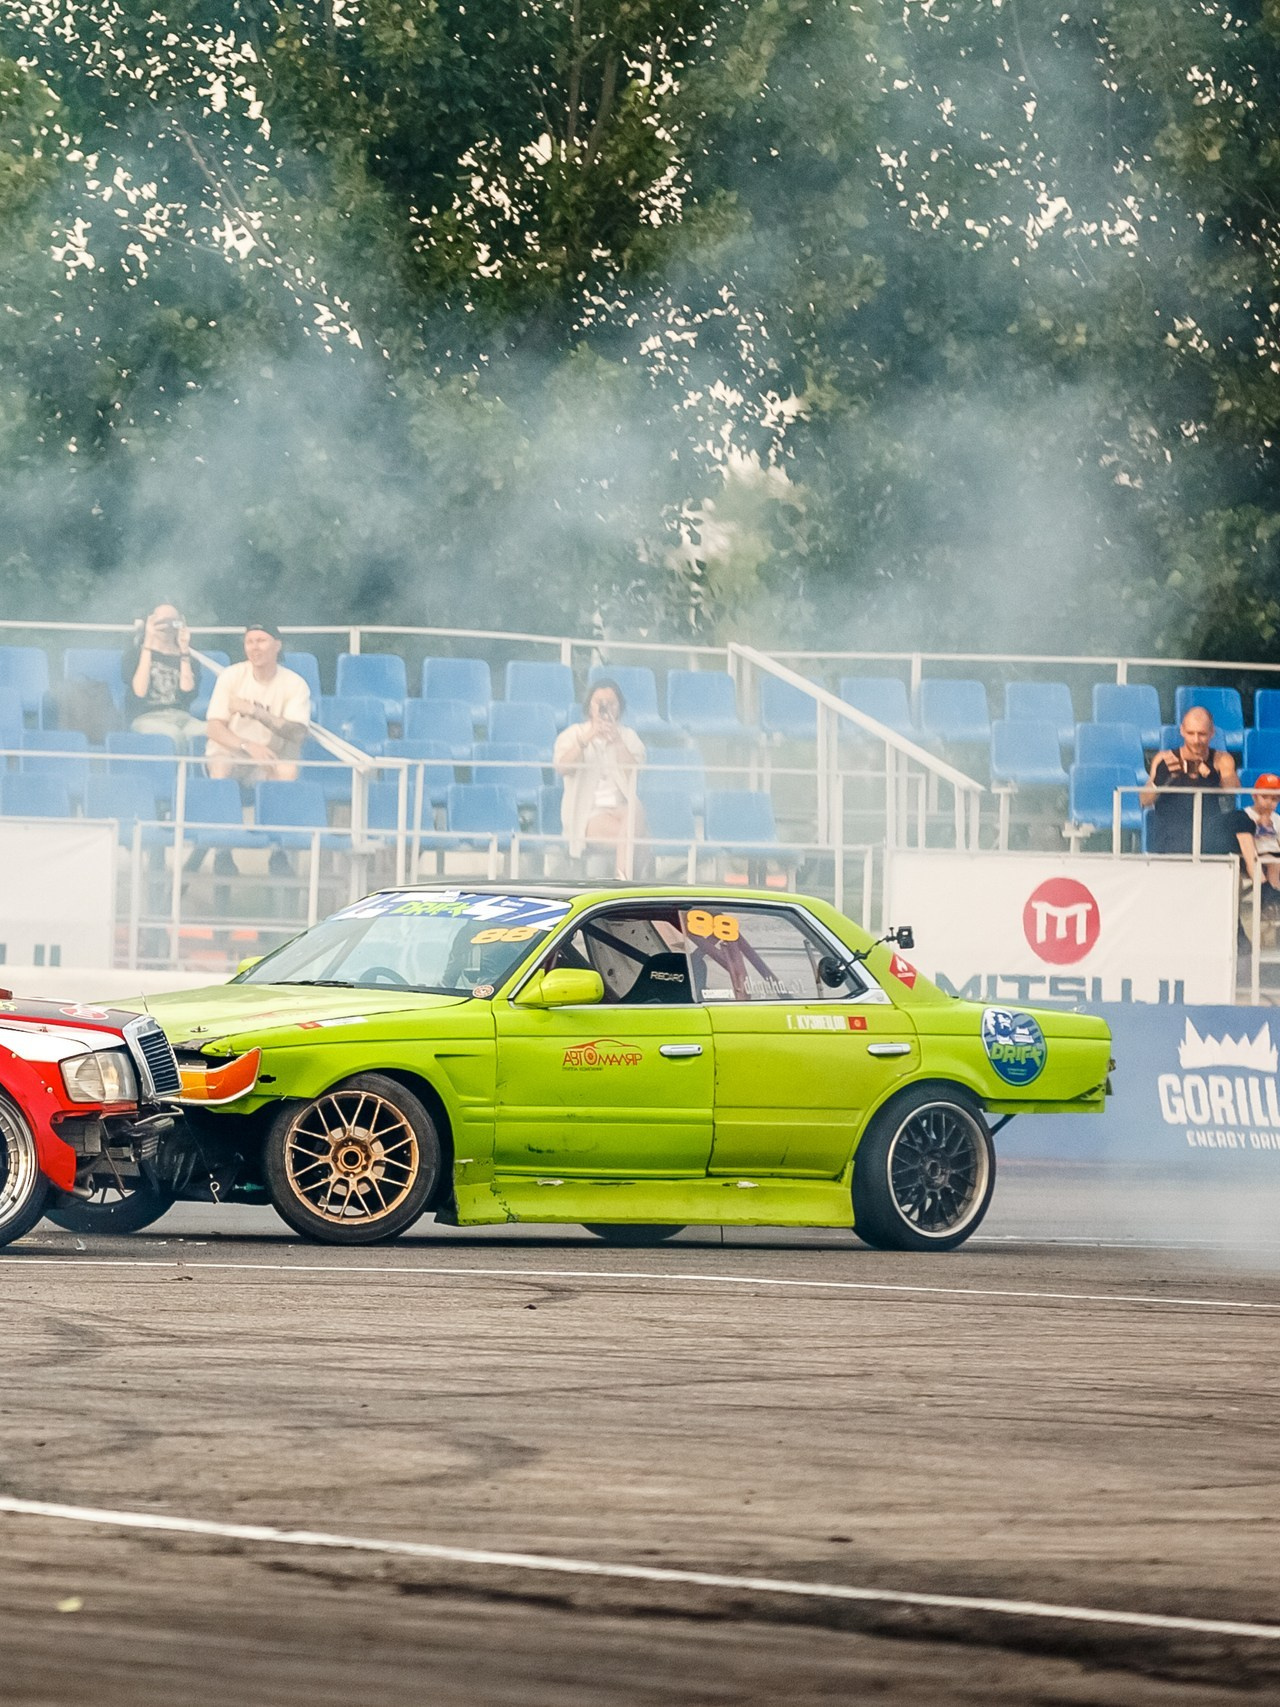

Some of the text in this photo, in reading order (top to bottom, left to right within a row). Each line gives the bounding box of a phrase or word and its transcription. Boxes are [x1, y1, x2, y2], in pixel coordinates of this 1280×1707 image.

[470, 926, 540, 944] 88
[687, 909, 739, 942] 88
[1186, 1129, 1246, 1149] ENERGY
